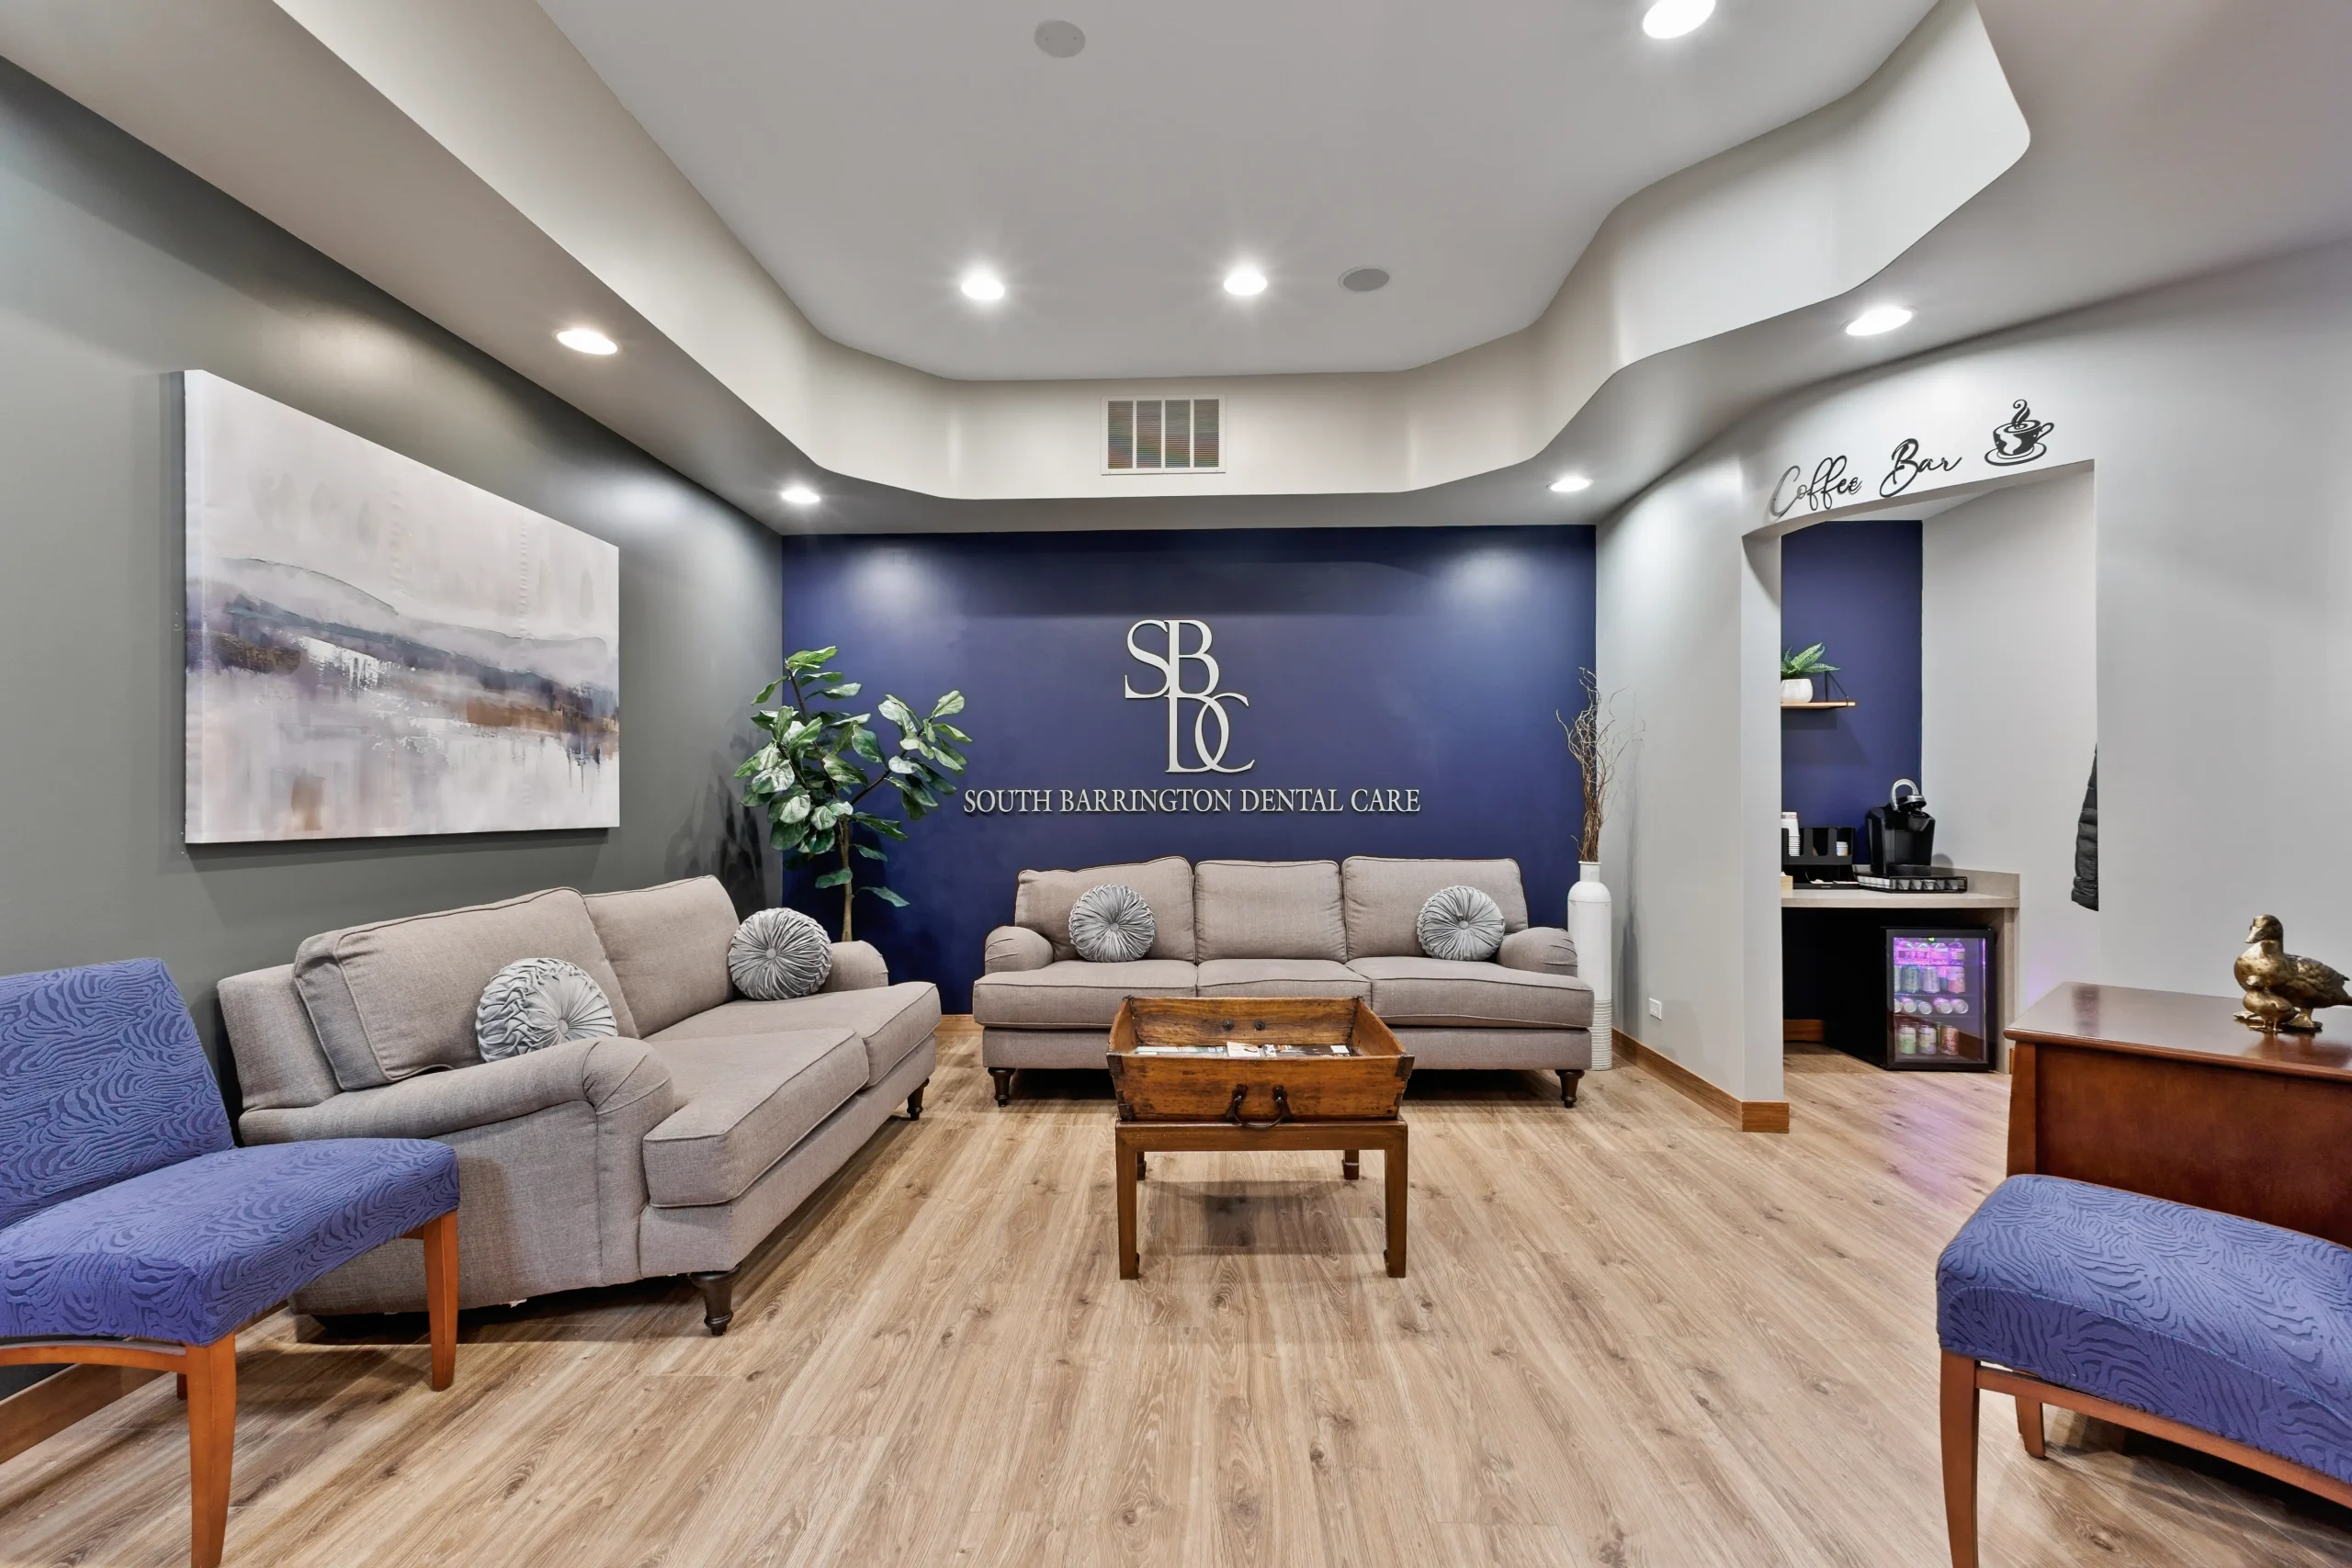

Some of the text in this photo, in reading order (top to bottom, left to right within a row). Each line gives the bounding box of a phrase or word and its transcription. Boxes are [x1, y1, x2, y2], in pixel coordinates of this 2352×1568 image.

[1770, 438, 1962, 519] Coffee Bar
[963, 788, 1421, 814] SOUTH BARRINGTON DENTAL CARE
